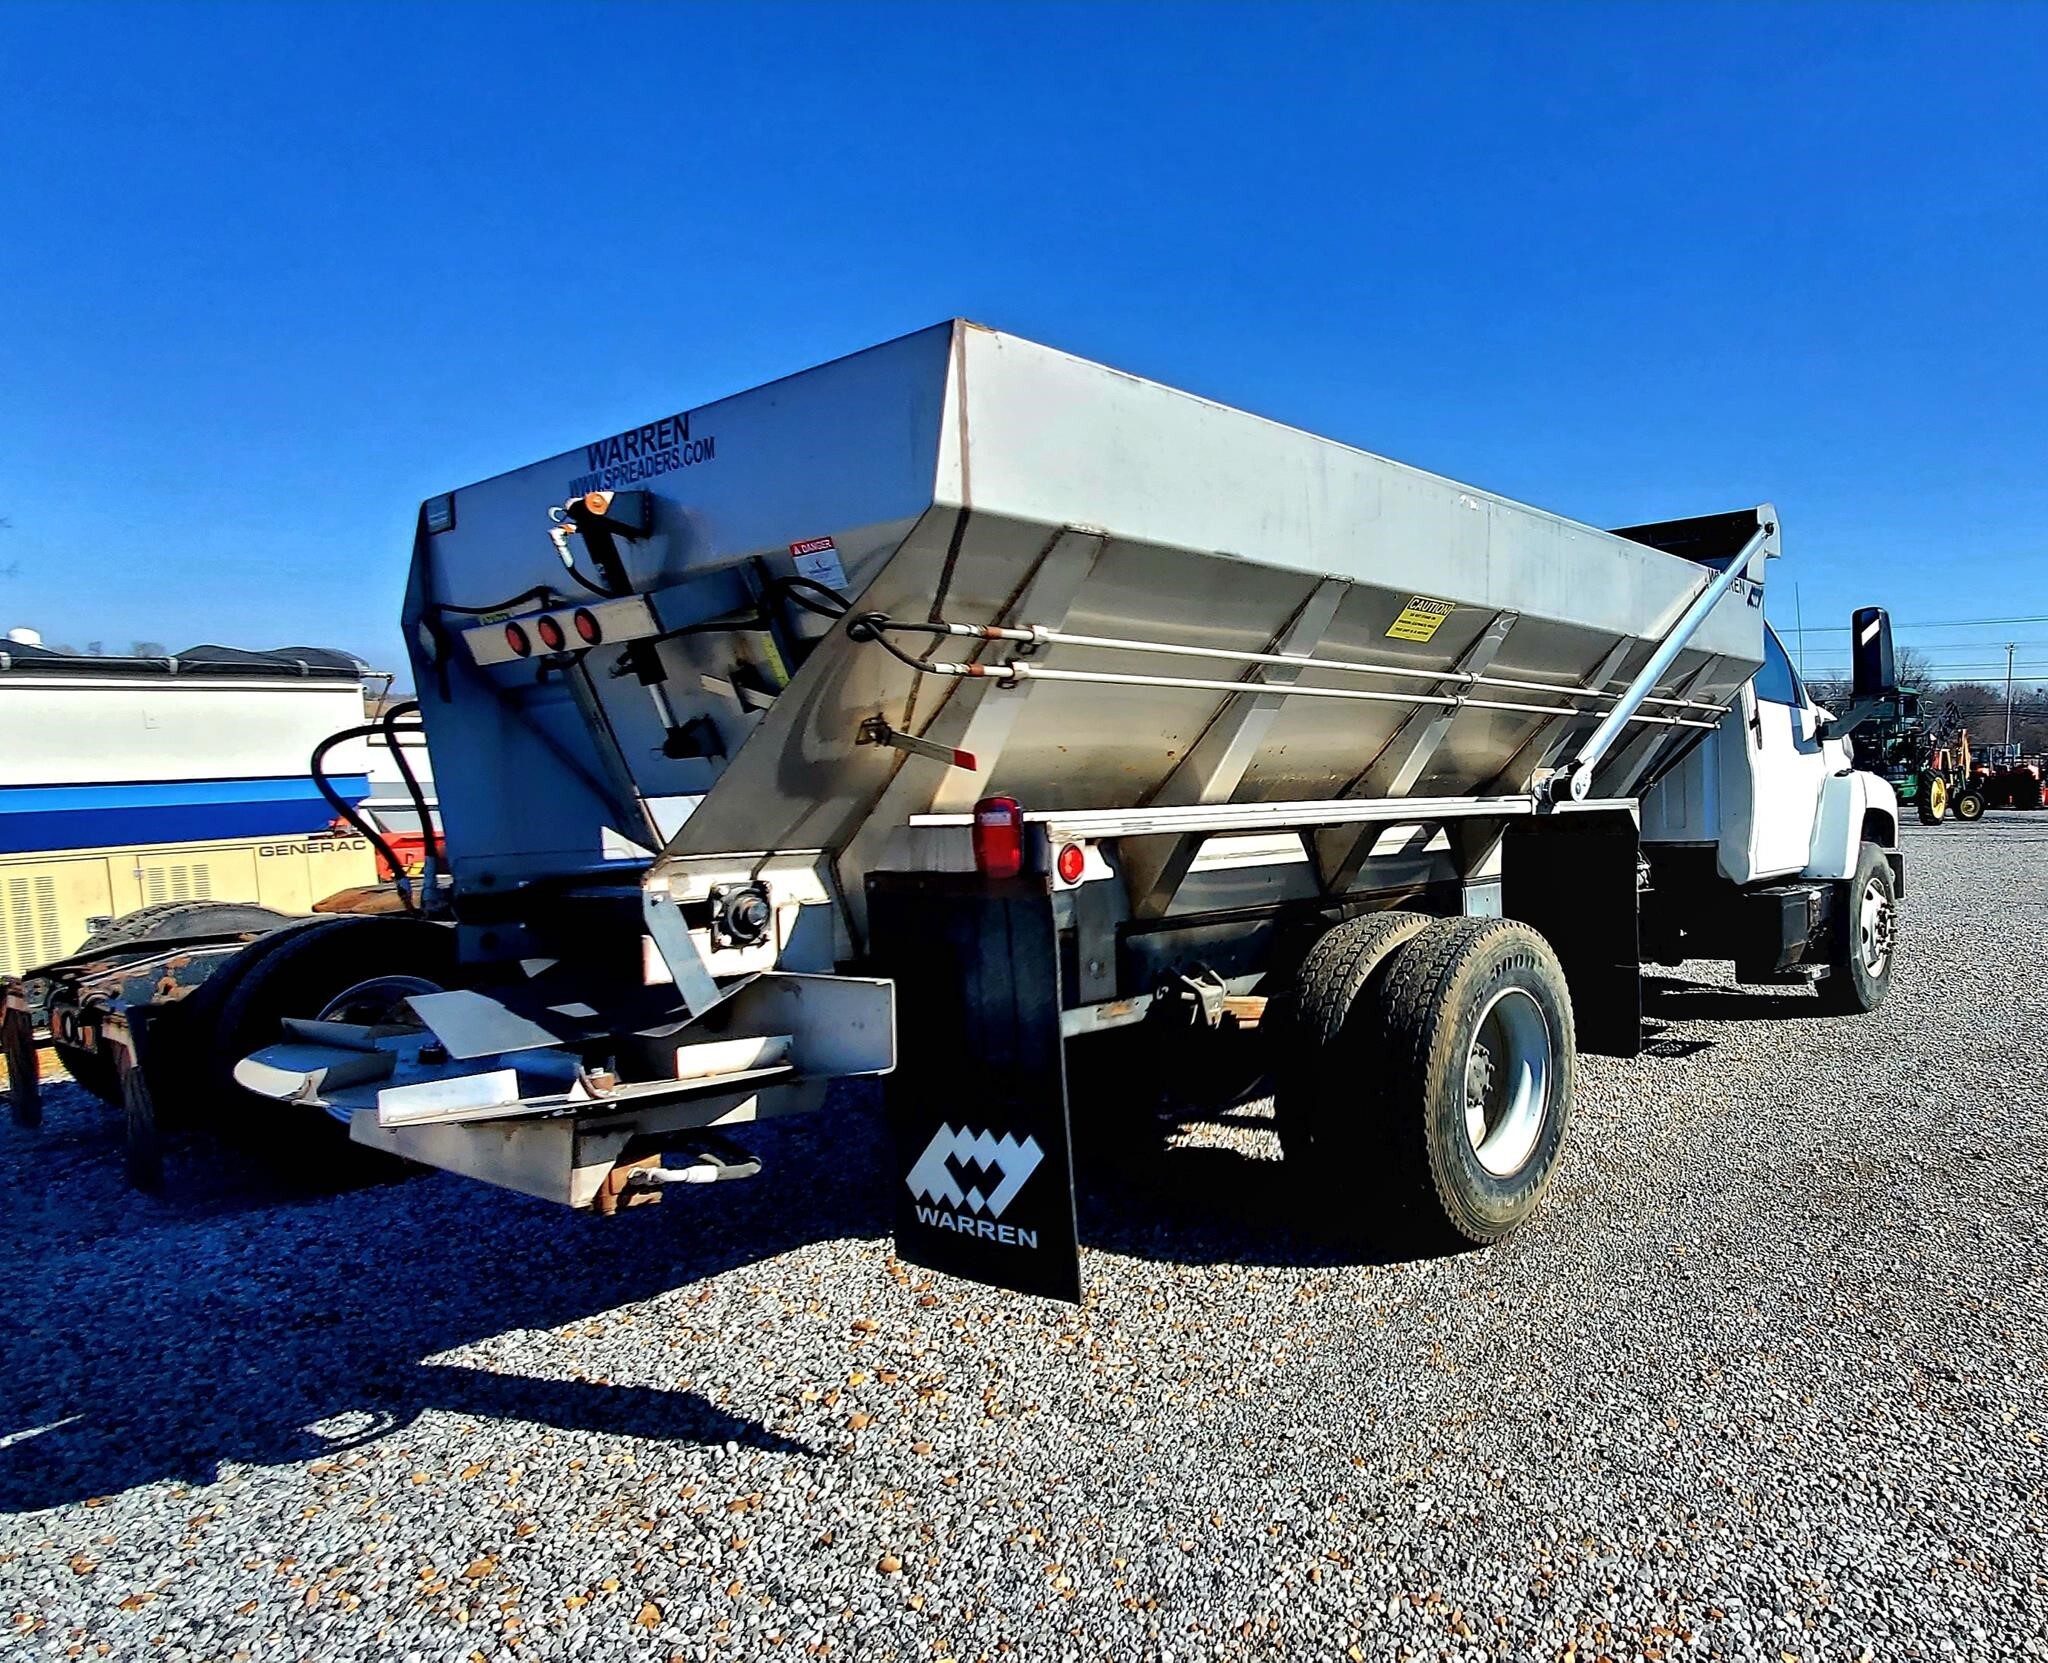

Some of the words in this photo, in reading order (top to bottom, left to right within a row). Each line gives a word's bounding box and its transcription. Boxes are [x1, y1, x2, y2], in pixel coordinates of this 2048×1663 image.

[587, 414, 690, 471] WARREN
[568, 436, 715, 496] WWW.SPREADERS.COM
[1410, 599, 1452, 615] CAUTION
[259, 840, 367, 857] GENERAC
[915, 1205, 1038, 1249] WARREN
